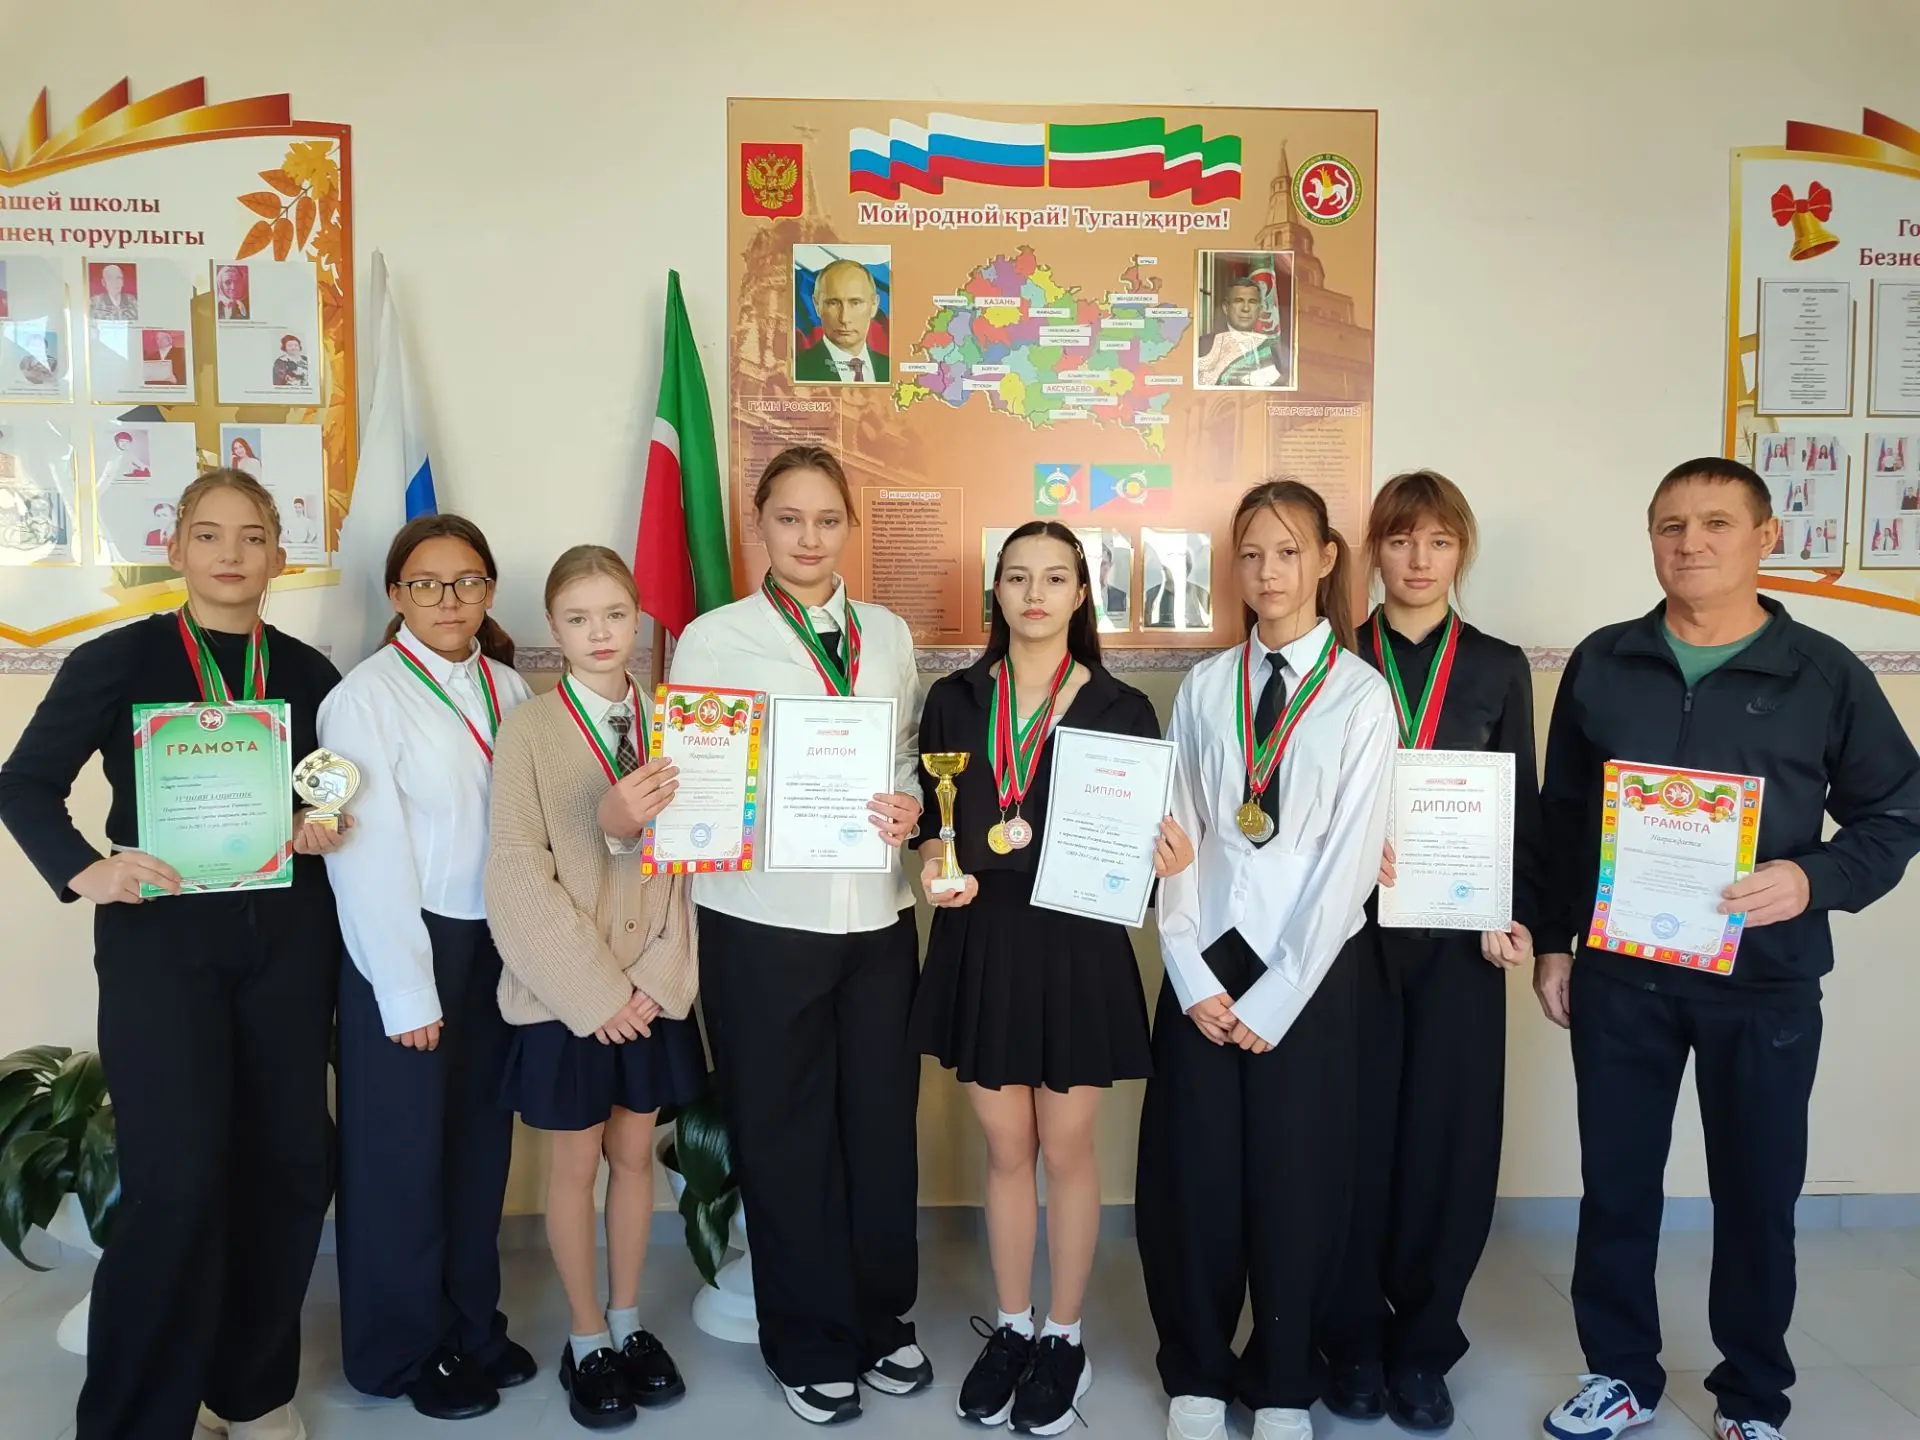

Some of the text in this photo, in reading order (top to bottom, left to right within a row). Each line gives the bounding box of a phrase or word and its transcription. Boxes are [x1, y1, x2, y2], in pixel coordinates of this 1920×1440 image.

[69, 197, 161, 213] школы
[859, 204, 909, 225] Мой
[914, 205, 999, 229] родной
[1004, 205, 1067, 230] край!
[1075, 207, 1140, 230] Туган
[60, 227, 205, 249] горурлыгы
[984, 298, 1016, 306] КАЗАНЬ
[1046, 385, 1092, 393] АКСУБАЕВО
[748, 400, 832, 413] ГИМН РОССИИ
[1267, 406, 1324, 417] ТАТАРСТАН
[166, 740, 259, 756] ГРАМОТА
[683, 735, 730, 747] ГРАМОТА
[806, 746, 857, 757] ДИПЛОМ
[1084, 783, 1132, 800] ДИПЛОМ
[1410, 799, 1482, 814] ДИПЛОМ
[1643, 815, 1711, 835] ГРАМОТА
